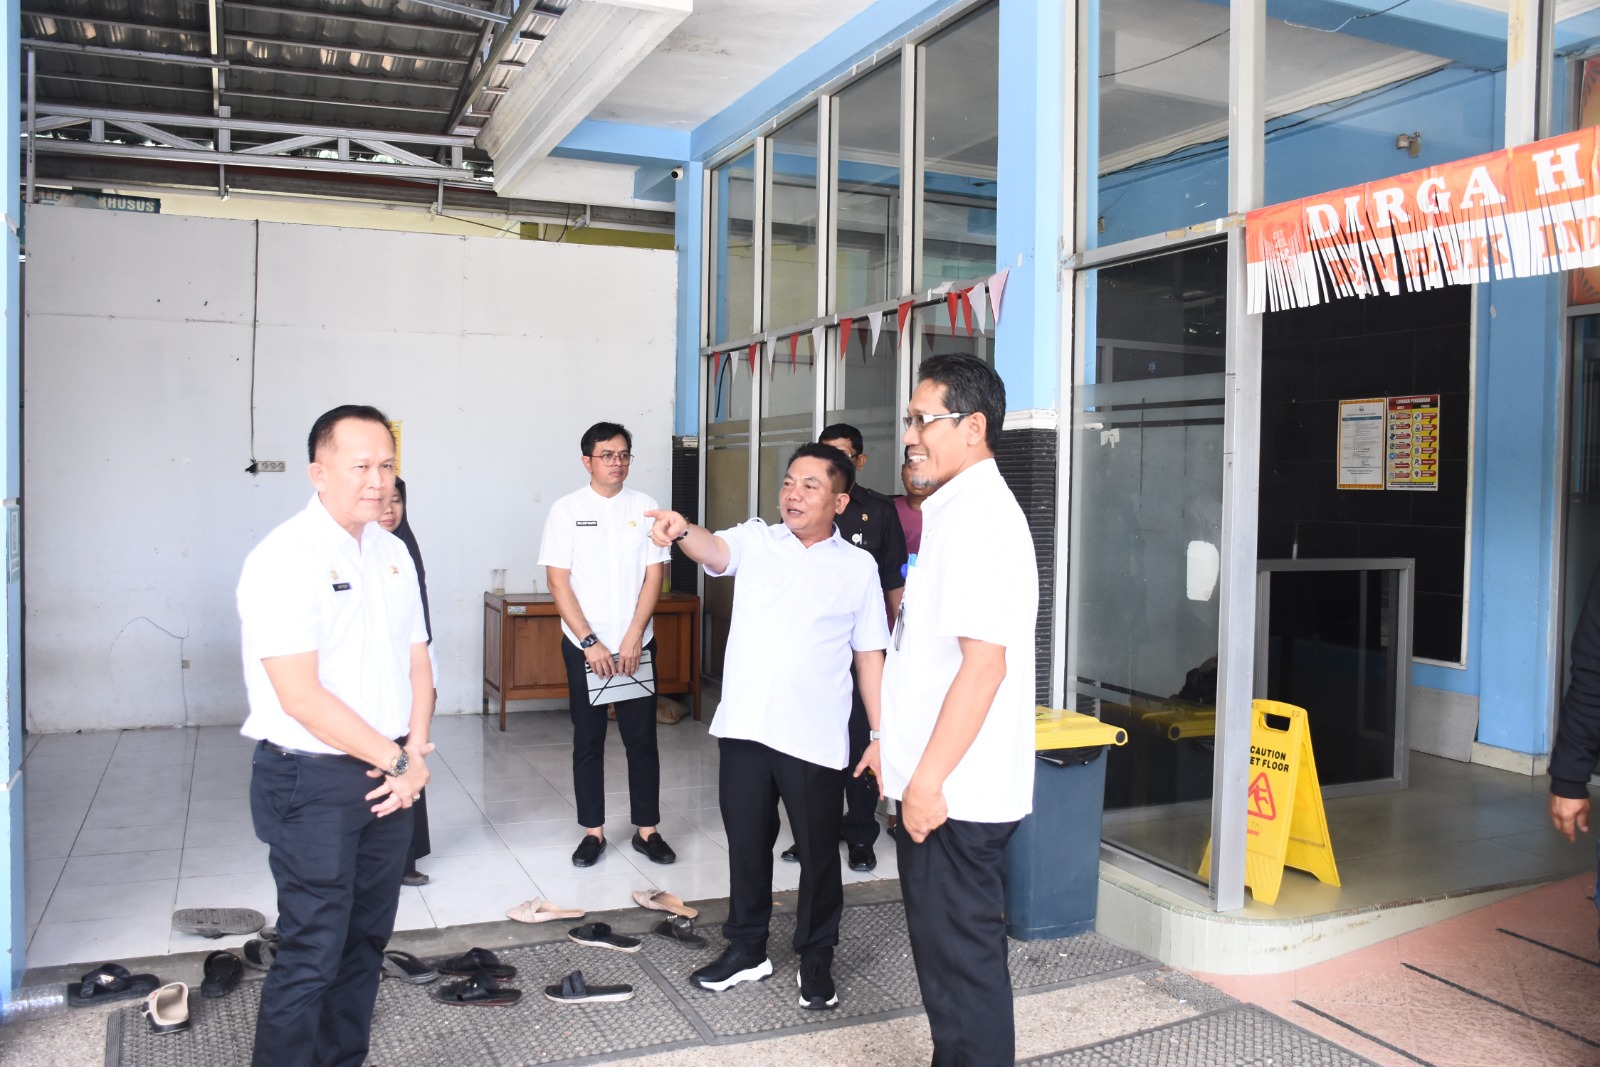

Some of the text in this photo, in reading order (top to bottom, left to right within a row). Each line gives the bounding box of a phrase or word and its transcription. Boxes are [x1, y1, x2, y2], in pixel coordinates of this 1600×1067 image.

[98, 196, 155, 212] KHUSUS
[1305, 166, 1506, 242] DIRGA
[1327, 233, 1509, 288] RUBLIK
[1250, 745, 1286, 760] CAUTION
[1250, 757, 1289, 772] ET FLOOR
